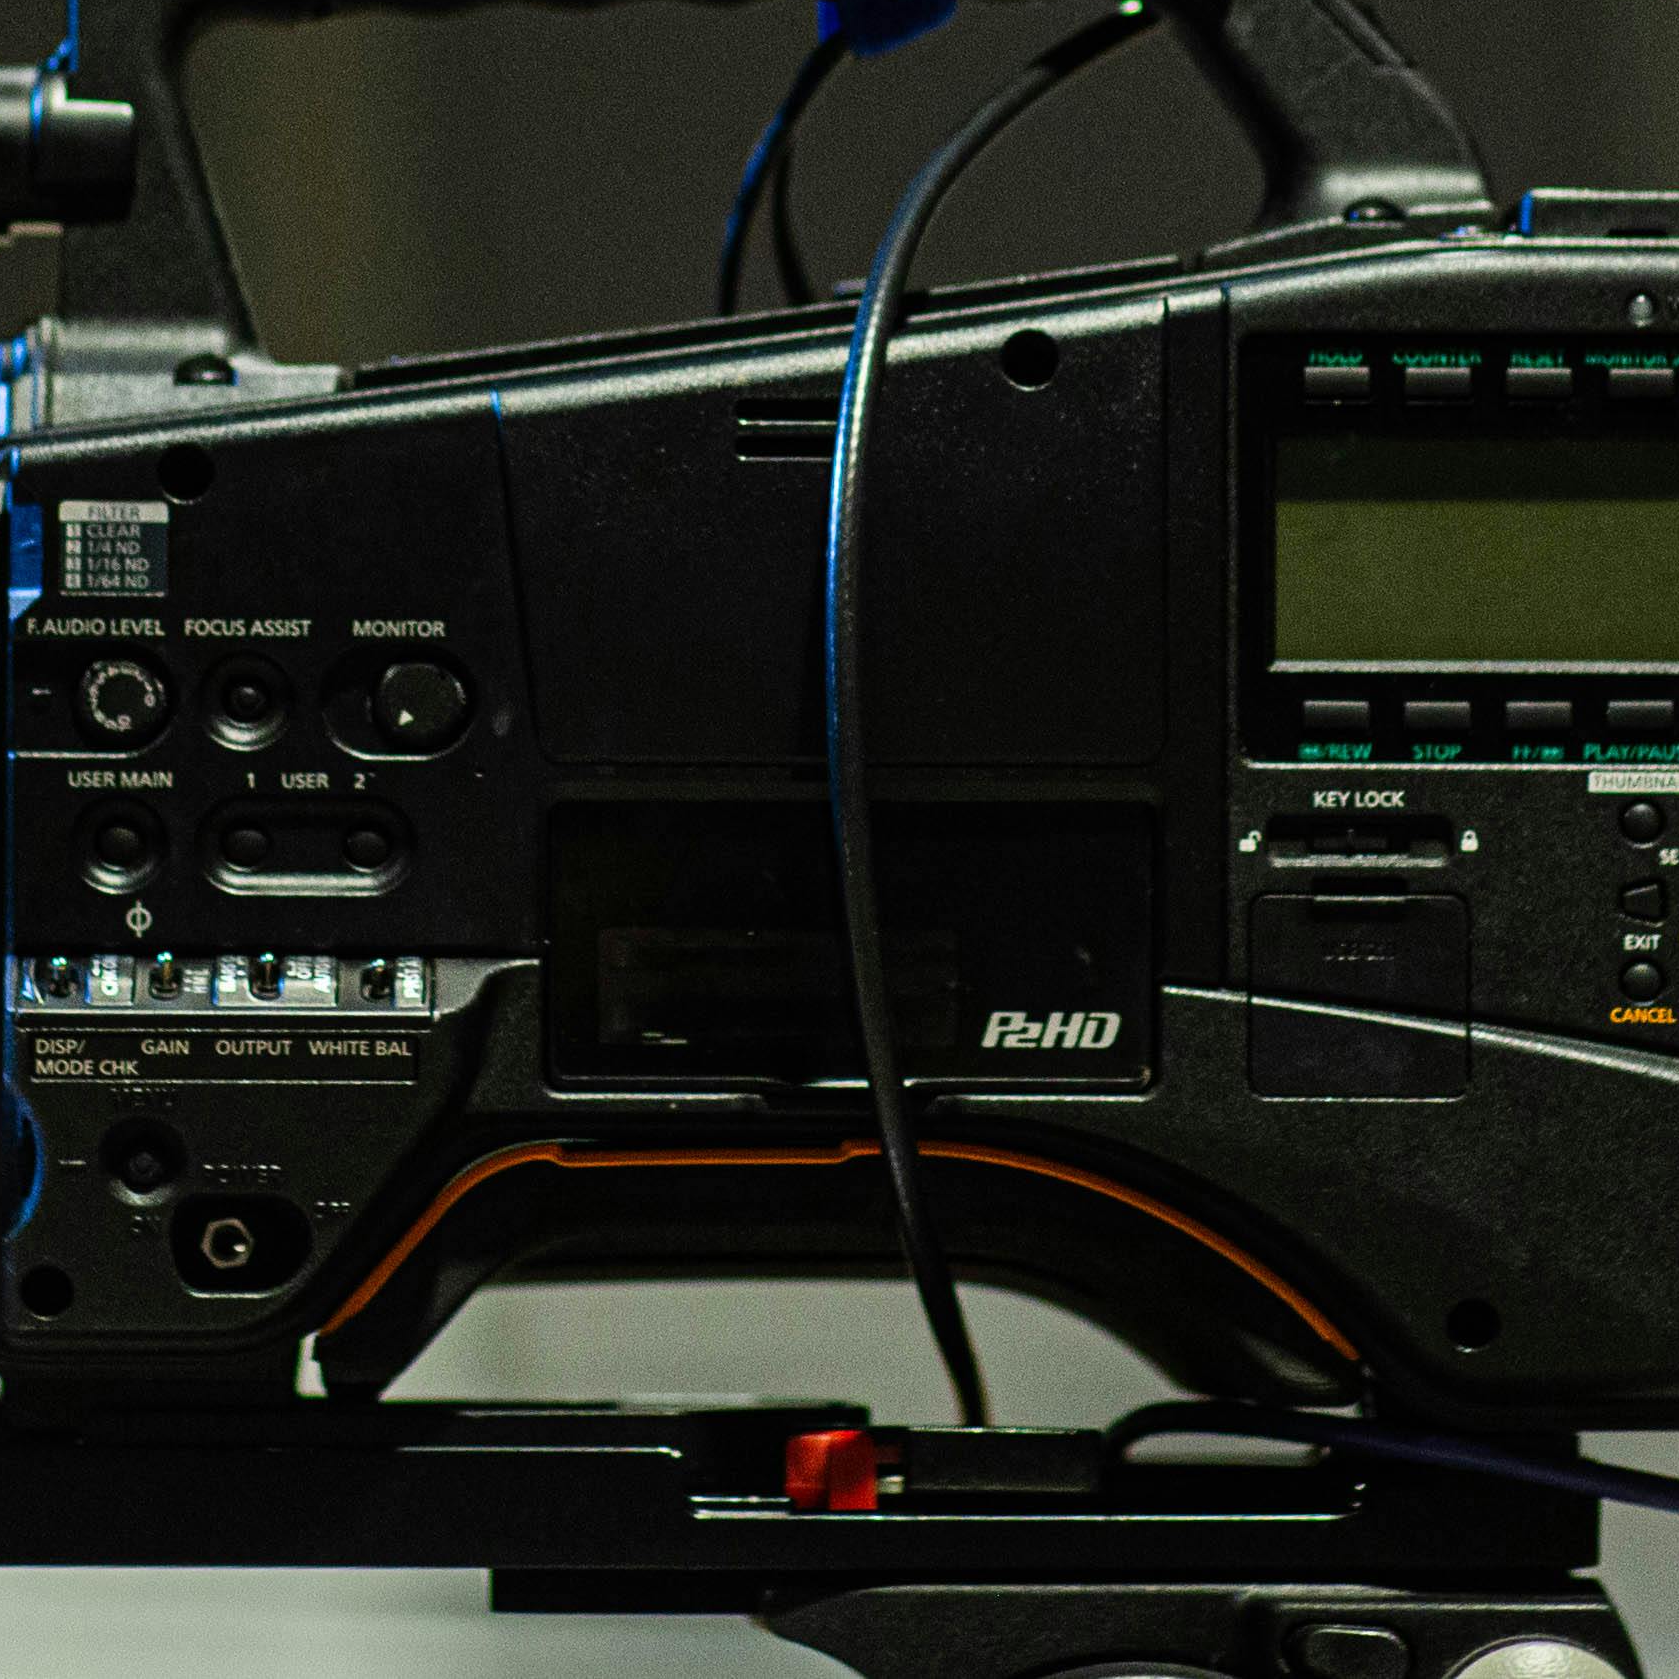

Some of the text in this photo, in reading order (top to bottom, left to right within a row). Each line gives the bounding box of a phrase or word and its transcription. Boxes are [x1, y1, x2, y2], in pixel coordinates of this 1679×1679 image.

[88, 505, 141, 522] FILTER
[86, 523, 140, 539] CLEAR
[87, 540, 112, 555] 1/4
[115, 540, 141, 555] ND
[87, 556, 123, 572] 1/16
[124, 556, 150, 572] ND
[87, 573, 121, 589] 1/64
[124, 573, 150, 589] ND
[110, 620, 166, 637] LEVEL
[184, 620, 312, 637] FOCUS ASSIST
[353, 620, 446, 638] MONITOR
[1412, 743, 1463, 760] STOP
[68, 771, 174, 789] USER MAIN
[247, 772, 367, 789] 1 USER 2
[1313, 790, 1406, 808] KEY LOCK
[1623, 934, 1662, 951] EXIT
[1609, 1007, 1677, 1024] CANCEL
[35, 1038, 85, 1056] DISP/
[141, 1038, 190, 1056] GAIN
[215, 1039, 293, 1056] OUTPUT
[308, 1039, 413, 1057] WHITE BAL
[35, 1058, 139, 1076] MODE CHK
